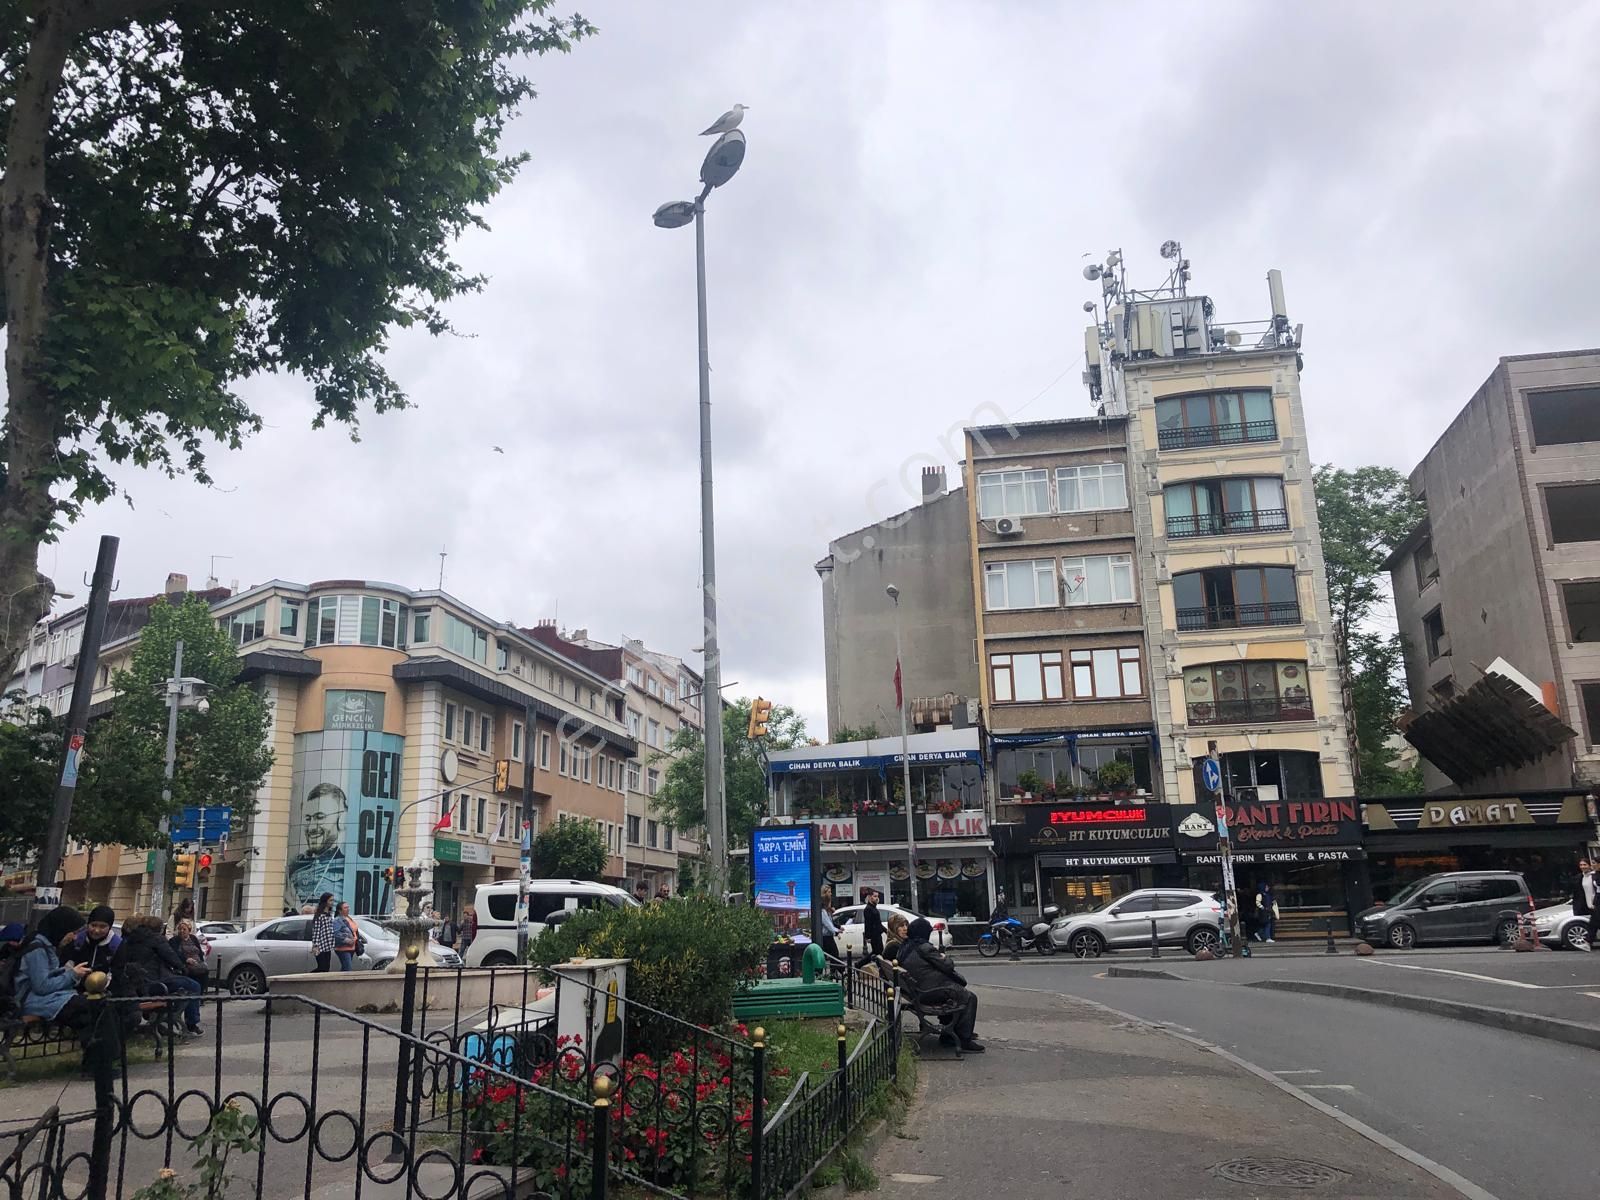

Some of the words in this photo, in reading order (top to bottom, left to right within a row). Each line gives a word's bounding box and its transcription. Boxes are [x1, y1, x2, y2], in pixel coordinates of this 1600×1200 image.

[945, 751, 967, 759] BALIK
[813, 761, 837, 769] DERYA
[839, 759, 861, 768] BALIK
[1287, 800, 1357, 823] FIRIN
[1430, 803, 1518, 825] DAMAT
[928, 818, 985, 837] BALIK
[1068, 830, 1086, 841] HT
[1088, 827, 1171, 841] KUYUMCULUK
[1065, 858, 1079, 866] HT
[1082, 856, 1152, 865] KUYUMCULUK
[1196, 855, 1222, 864] RANT
[1231, 854, 1255, 862] FIRIN
[1264, 853, 1298, 862] EKMEK
[1307, 852, 1315, 860] &
[1318, 851, 1349, 860] PASTA
